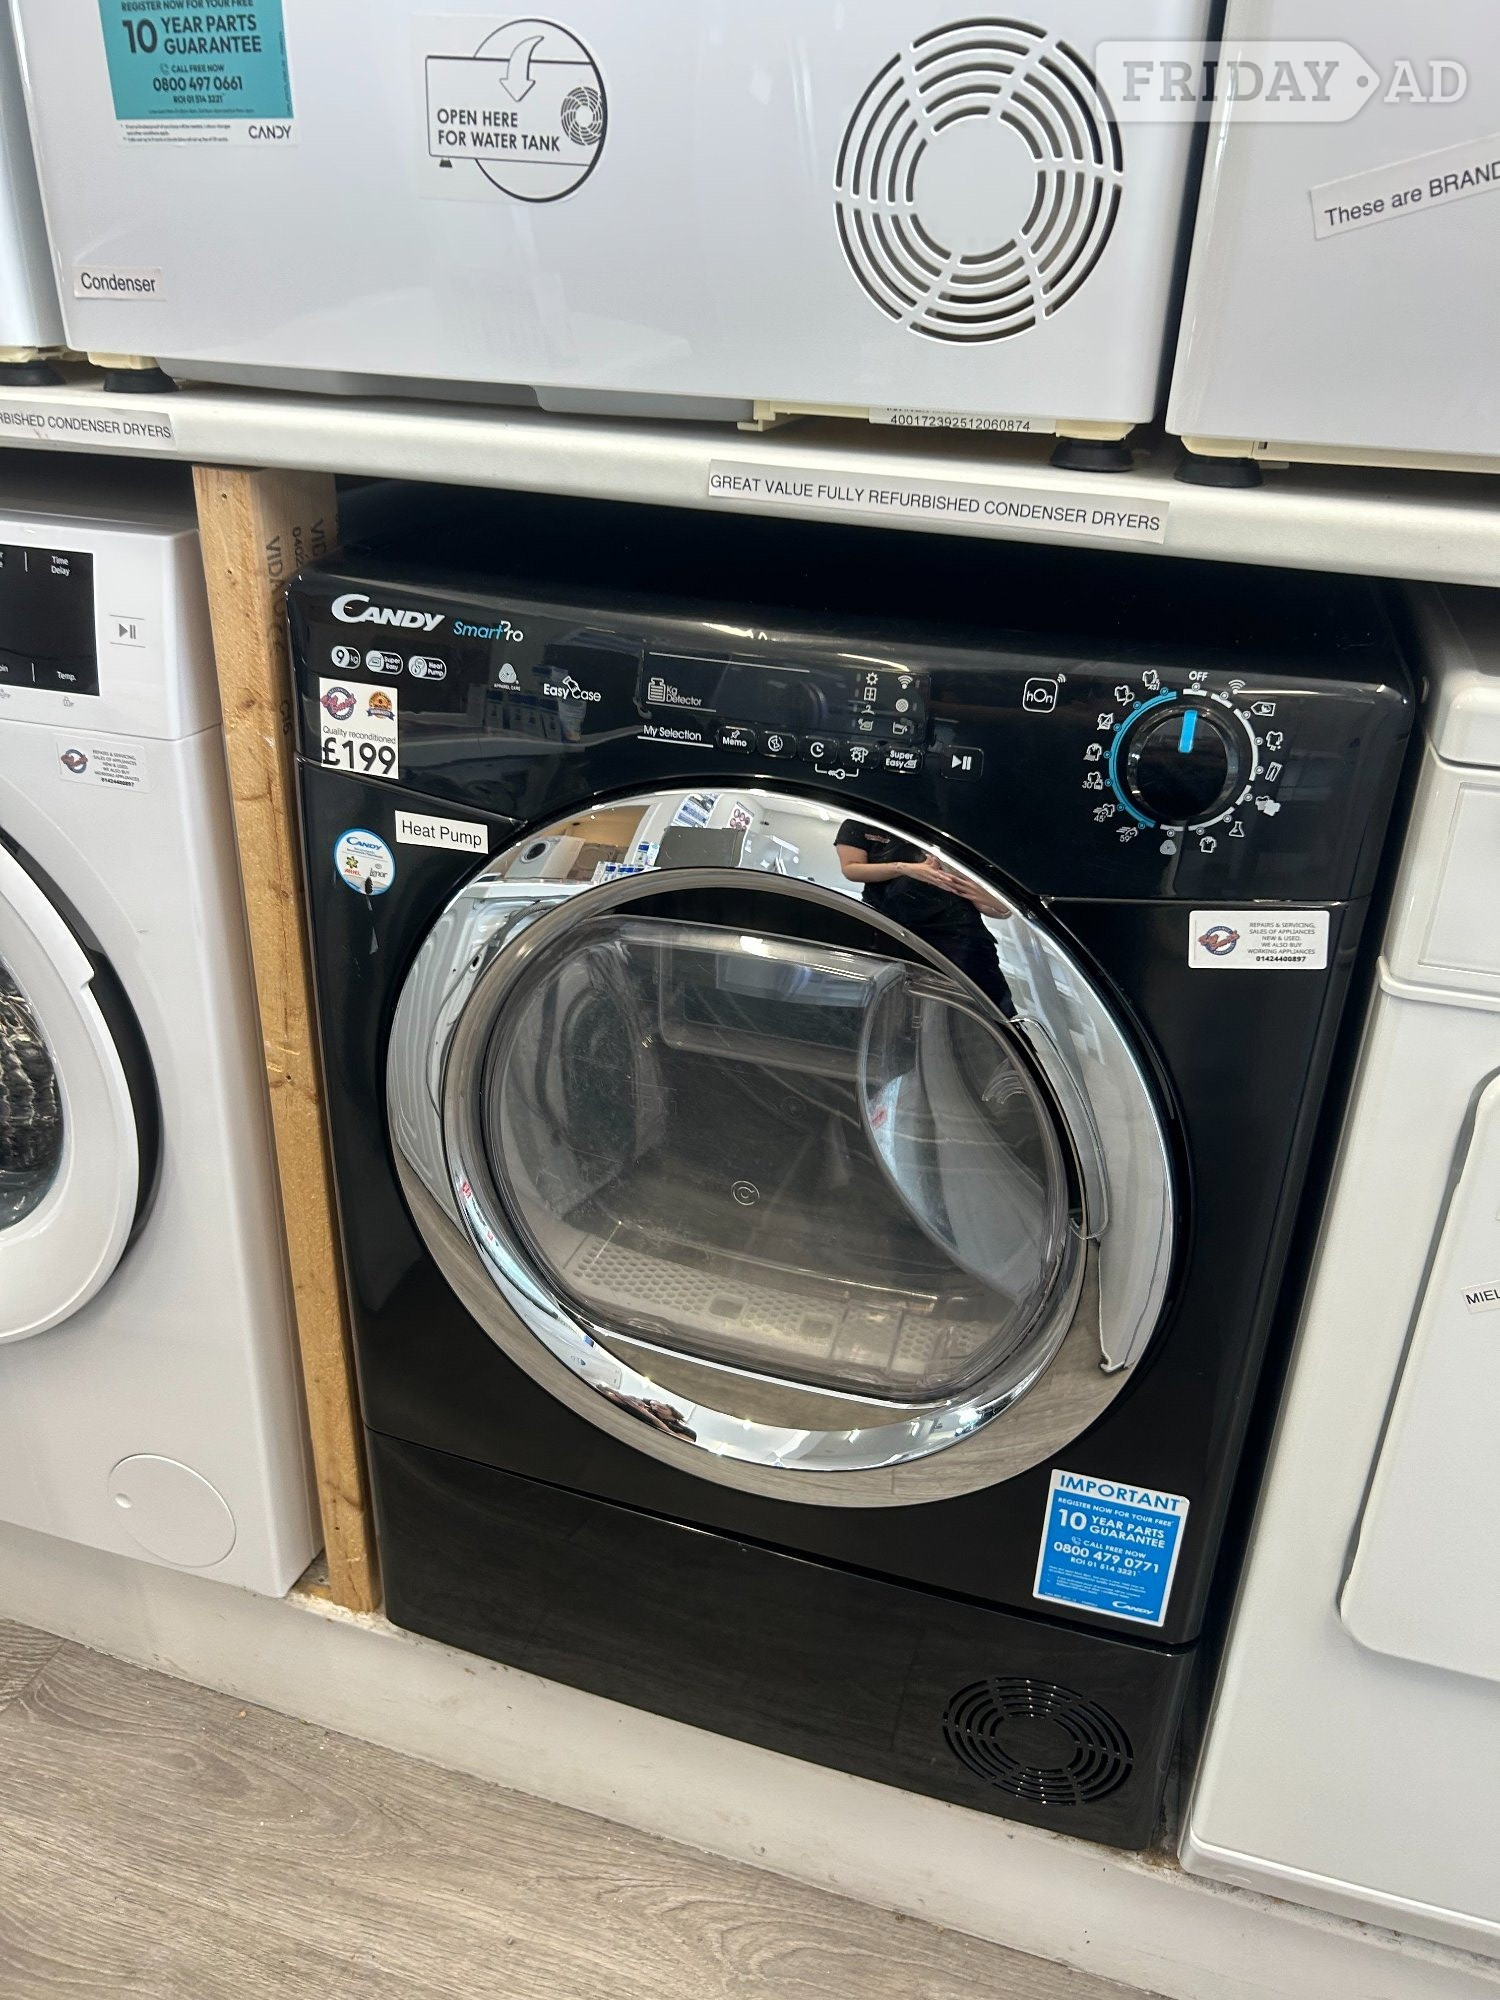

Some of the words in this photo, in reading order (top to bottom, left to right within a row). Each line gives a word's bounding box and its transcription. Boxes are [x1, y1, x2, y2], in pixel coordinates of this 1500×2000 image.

[122, 1, 161, 12] REGISTER
[163, 0, 184, 9] NOW
[186, 0, 202, 8] FOR
[205, 0, 229, 8] YOUR
[161, 16, 203, 34] YEAR
[207, 14, 257, 31] PARTS
[122, 18, 158, 53] 10
[164, 35, 262, 55] GUARANTEE
[171, 64, 188, 73] CALL
[189, 64, 206, 73] FREE
[207, 64, 225, 72] NOW
[153, 76, 187, 92] 0800
[189, 76, 210, 91] 497
[213, 76, 243, 91] 0661
[437, 108, 477, 126] OPEN
[482, 111, 518, 128] HERE
[248, 125, 292, 139] CANDY
[438, 130, 466, 147] FOR
[471, 132, 517, 150] WATER
[522, 134, 561, 152] TANK
[1324, 200, 1385, 227] These
[1391, 188, 1422, 209] are
[80, 272, 156, 294] Condenser
[47, 416, 121, 434] CONDENSER
[123, 422, 172, 439] DRYERS
[711, 474, 761, 492] GREAT
[764, 479, 814, 497] VALUE
[817, 485, 865, 502] FULLY
[868, 490, 980, 513] REFURBISHED
[984, 500, 1086, 523] CONDENSER
[1091, 511, 1160, 531] DRYERS
[51, 555, 69, 566] Time
[51, 565, 70, 577] Delay
[331, 593, 445, 632] CANDY
[384, 656, 401, 664] Super
[385, 663, 399, 671] Easy
[428, 661, 443, 669] Heat
[56, 670, 77, 682] Temp.
[427, 668, 444, 676] Pump
[1188, 671, 1208, 682] OFF
[666, 685, 678, 695] Kg
[1026, 688, 1053, 704] hOn
[666, 694, 702, 706] Detector
[322, 725, 348, 738] Quality
[348, 731, 396, 745] reconditioned
[643, 724, 657, 738] My
[659, 726, 702, 741] Selection
[722, 736, 747, 747] Memo
[322, 737, 396, 775] £199
[885, 757, 904, 769] Easy
[890, 750, 914, 760] Super
[402, 820, 436, 839] Heat
[440, 826, 482, 848] Pump
[346, 836, 383, 850] CANDY
[1060, 1475, 1180, 1512] IMPORTANT
[1057, 1497, 1091, 1510] REGISTER
[1093, 1505, 1113, 1514] NOW
[1114, 1509, 1129, 1518] FOR
[1132, 1513, 1153, 1523] YOUR
[1058, 1508, 1087, 1531] 10
[1091, 1515, 1124, 1530] YEAR
[1126, 1523, 1165, 1539] PARTS
[1089, 1525, 1166, 1549] GUARANTEE
[1053, 1541, 1089, 1558] 0800
[1093, 1551, 1120, 1565] 479
[1124, 1558, 1159, 1574] 0771
[1083, 1540, 1103, 1550] CALL
[1105, 1545, 1123, 1554] FREE
[1125, 1549, 1146, 1559] NOW
[1070, 1557, 1086, 1565] ROI
[1099, 1563, 1115, 1572] 514
[1112, 1600, 1154, 1615] CANDY
